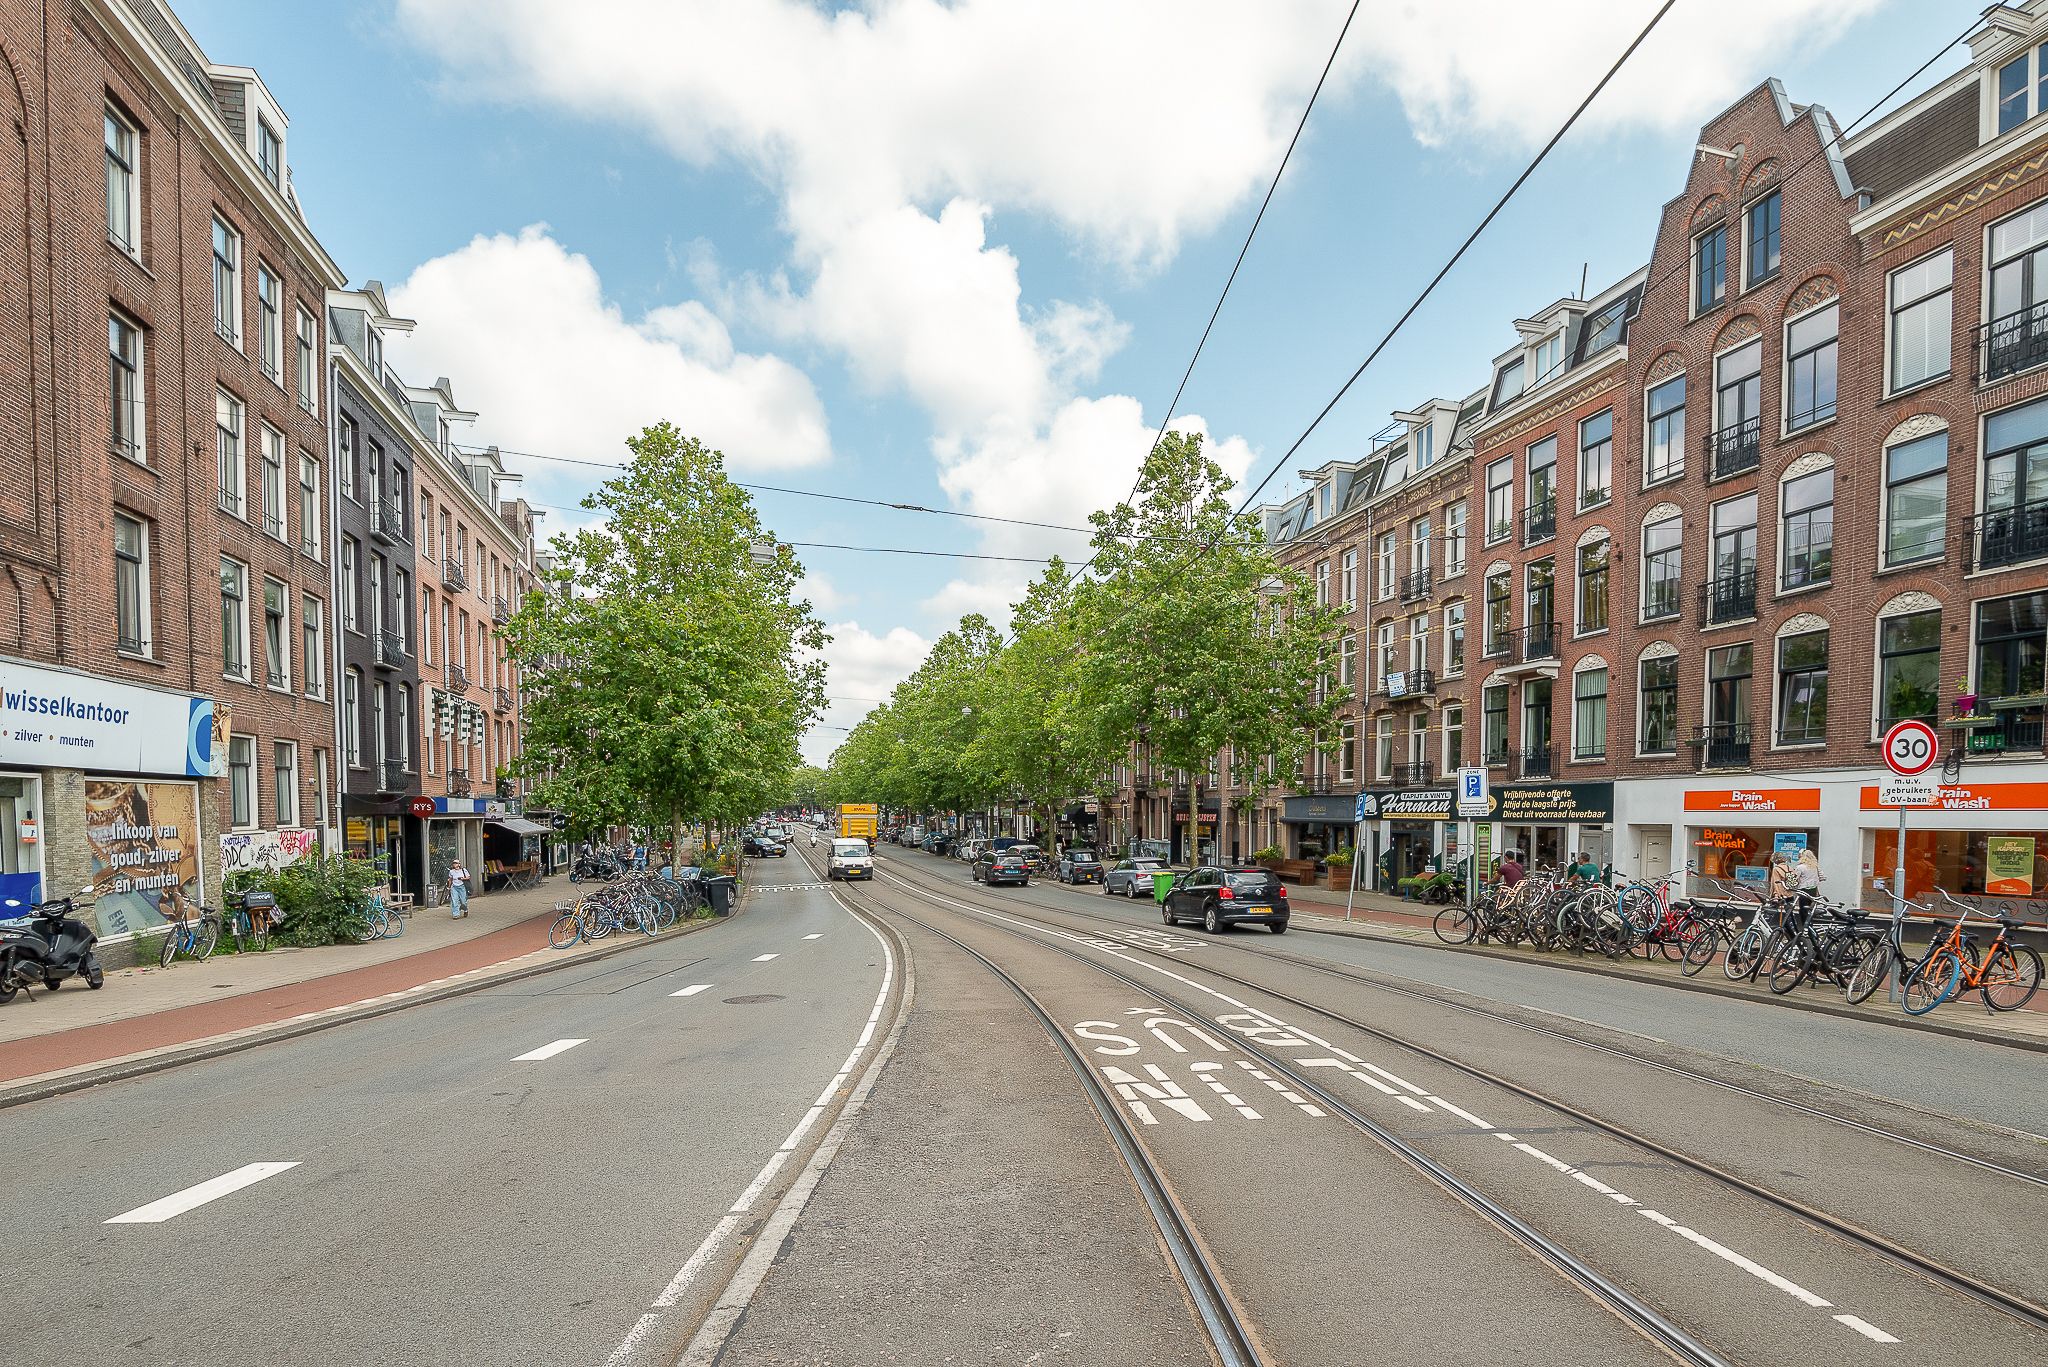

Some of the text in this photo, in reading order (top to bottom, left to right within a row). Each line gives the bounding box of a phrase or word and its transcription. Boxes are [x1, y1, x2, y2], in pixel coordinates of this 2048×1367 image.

[0, 687, 129, 724] wisselkantoor
[14, 729, 94, 748] zilver munten
[1894, 738, 1928, 759] 30
[1503, 789, 1572, 800] Vrijblijvende offerte
[1731, 790, 1763, 802] Brain
[1886, 787, 1932, 796] gebruikers
[413, 803, 432, 811] RYS
[1380, 793, 1451, 813] Harman
[1502, 799, 1577, 810] Altijd de laagste prijs
[1742, 800, 1776, 810] Wash
[1942, 796, 1990, 809] Wash
[1176, 813, 1191, 821] QUIC
[1502, 810, 1607, 818] Direct uit voorraad leverbaar
[111, 823, 177, 841] Inkoop van
[1703, 828, 1733, 840] Brain
[1714, 838, 1745, 849] Wash
[111, 847, 181, 870] goud, zilver
[115, 872, 179, 892] en munten
